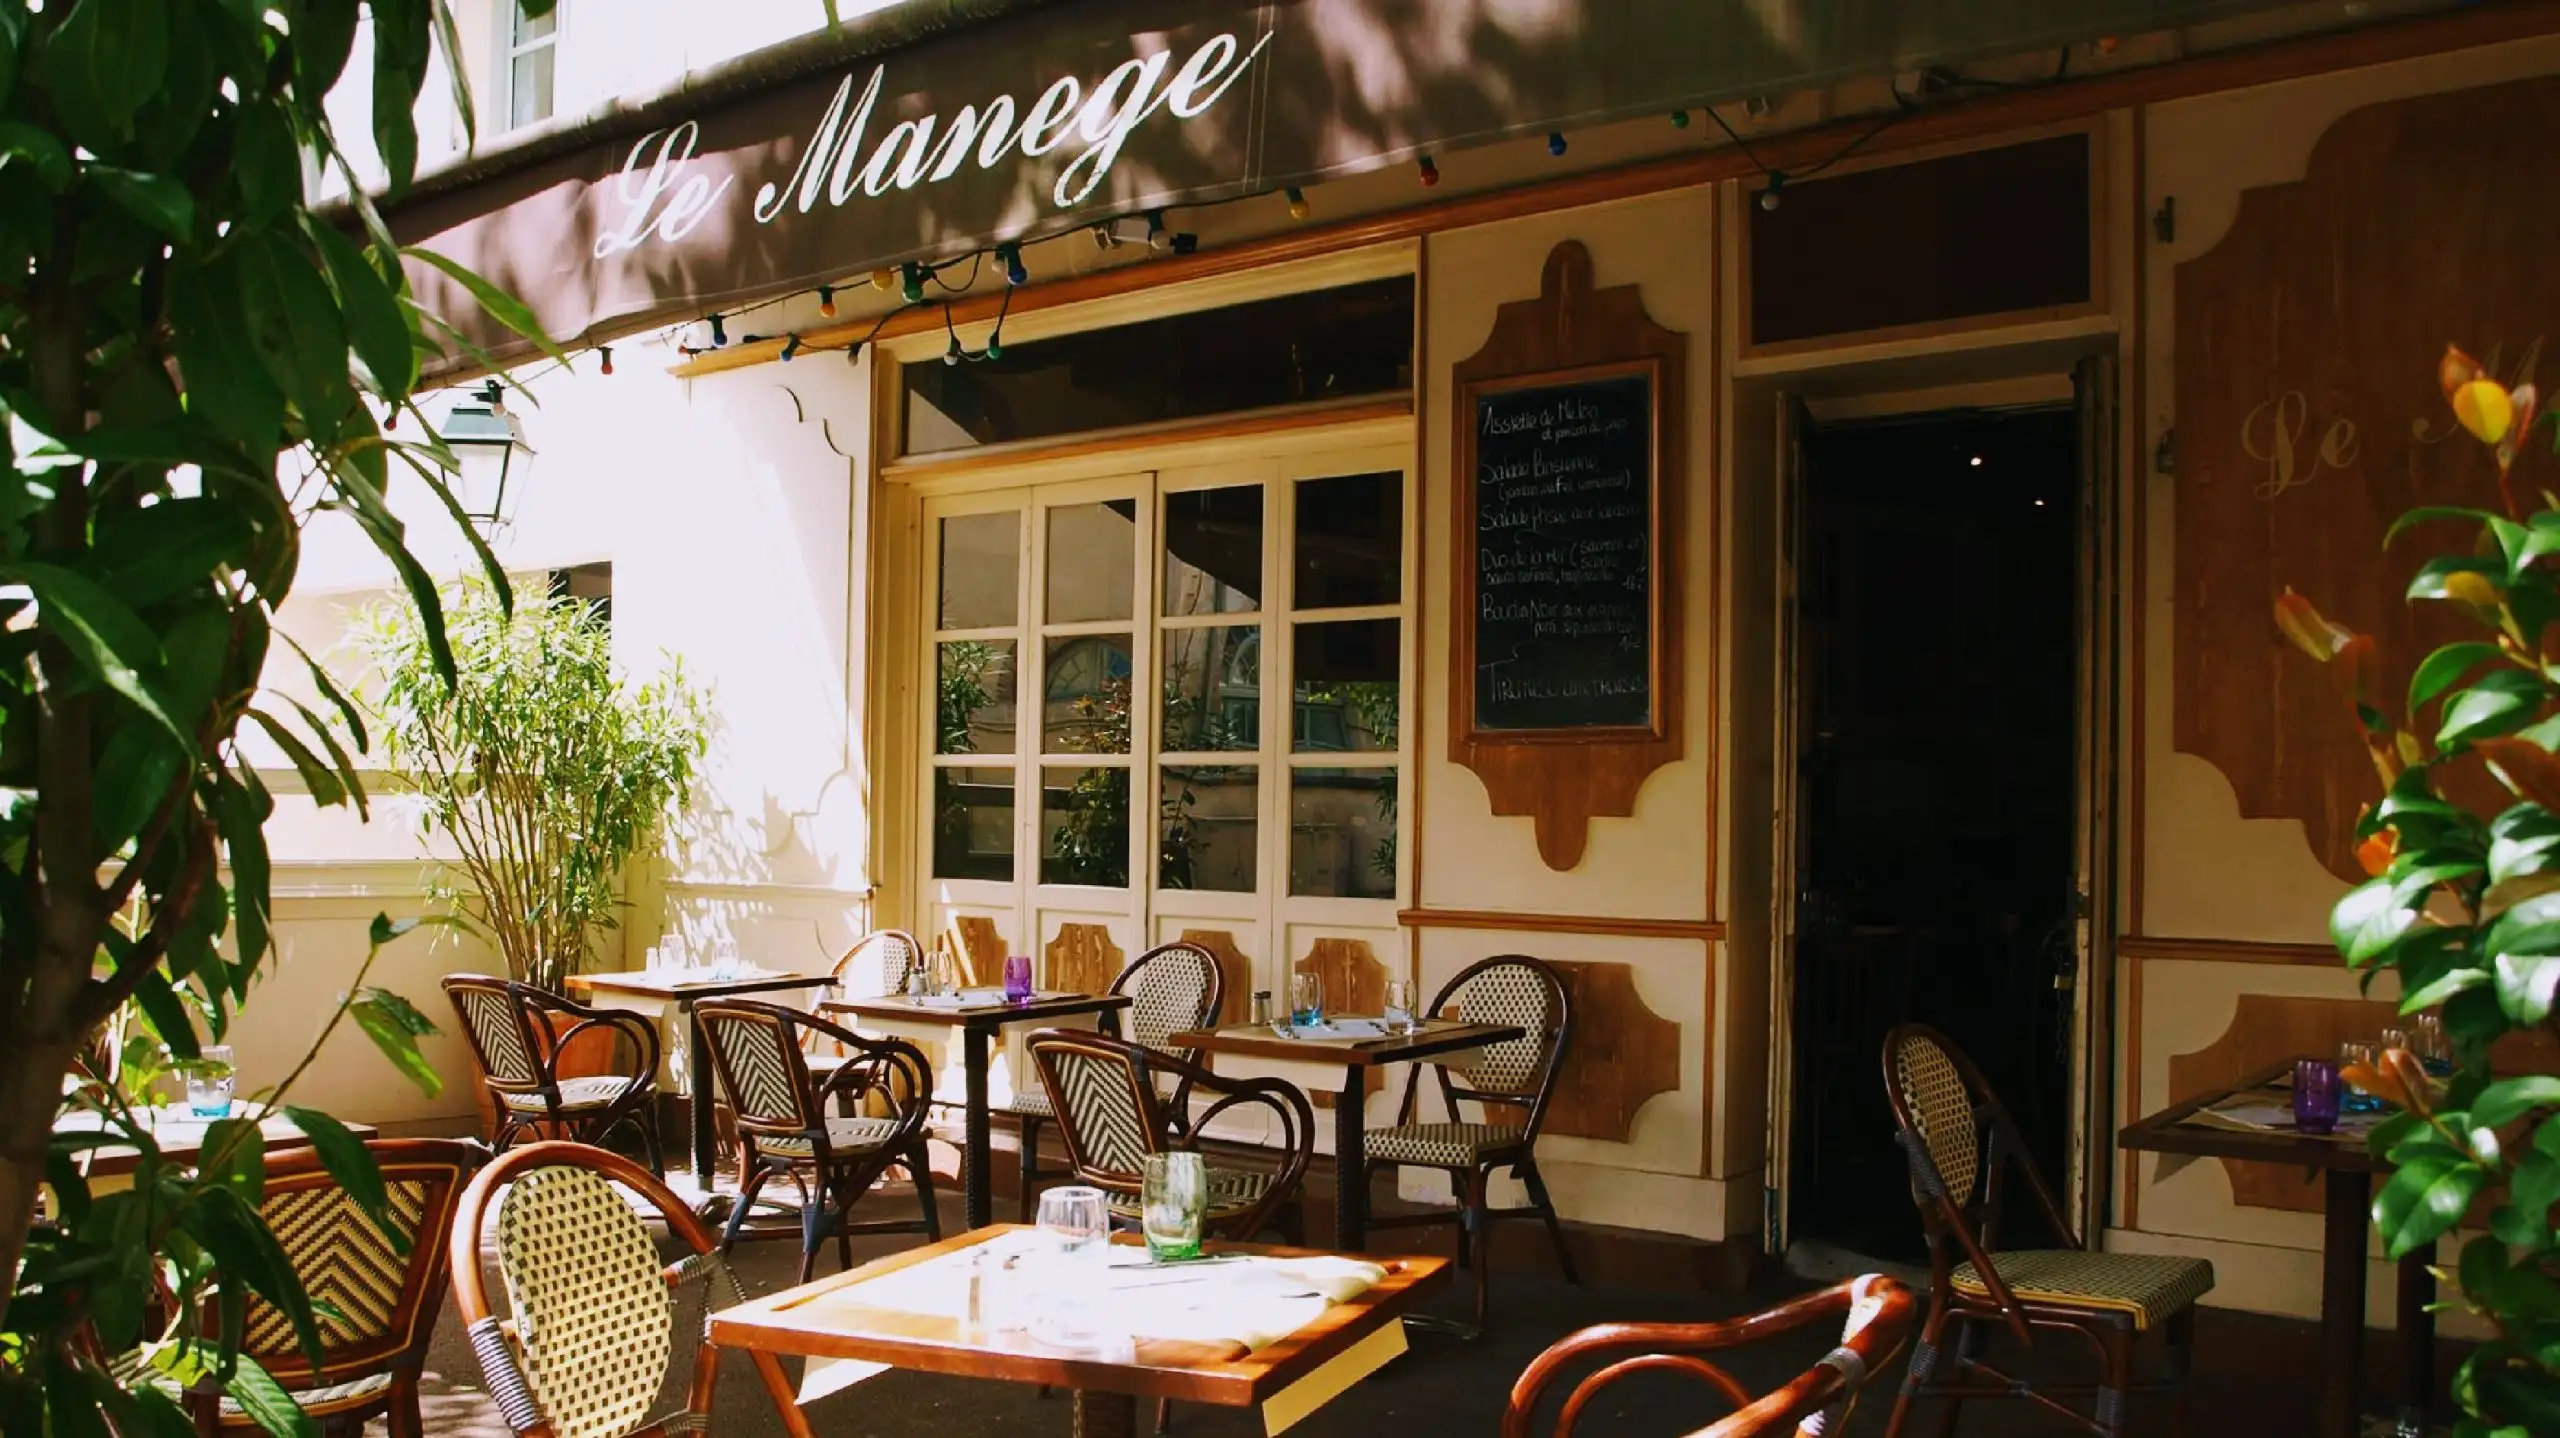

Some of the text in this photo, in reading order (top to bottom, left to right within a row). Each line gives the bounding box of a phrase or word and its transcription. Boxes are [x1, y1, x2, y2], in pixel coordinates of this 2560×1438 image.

[594, 29, 1274, 260] Le Manege
[2240, 389, 2361, 500] Le
